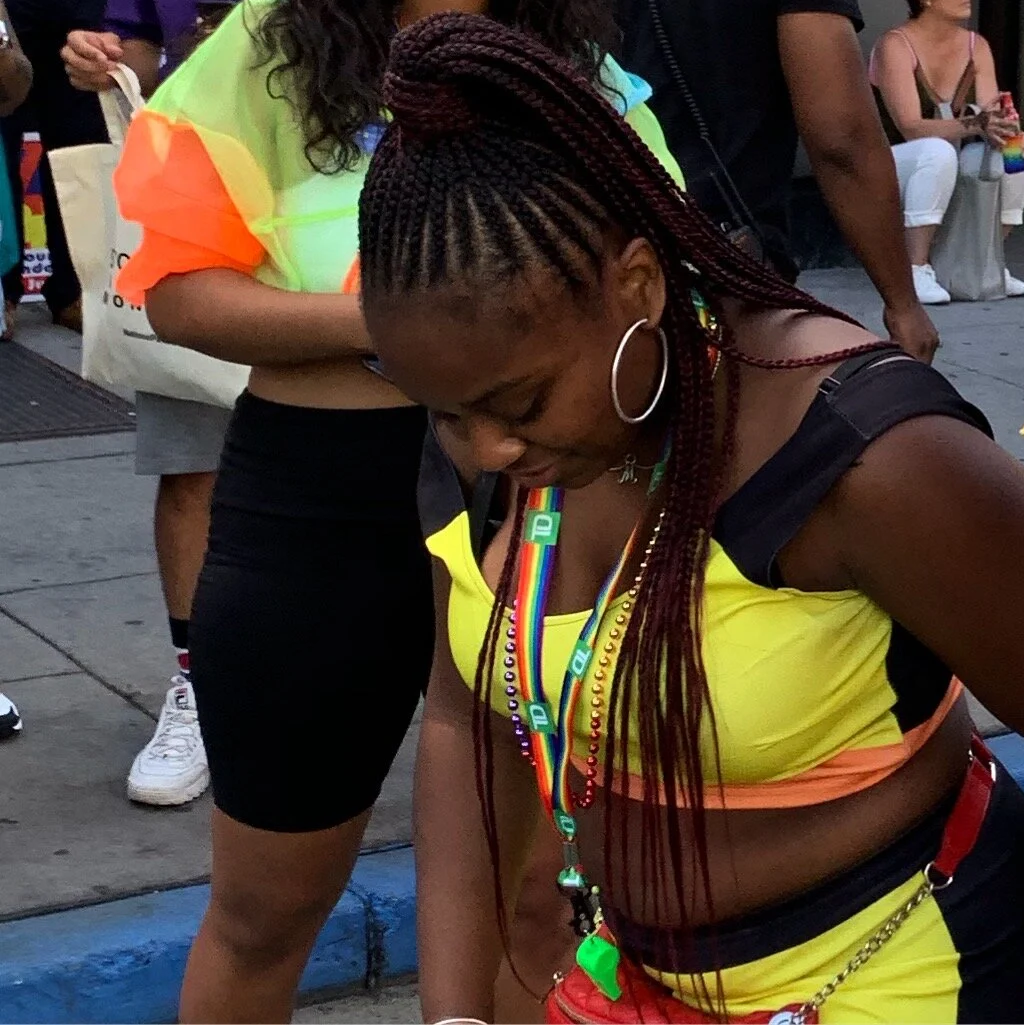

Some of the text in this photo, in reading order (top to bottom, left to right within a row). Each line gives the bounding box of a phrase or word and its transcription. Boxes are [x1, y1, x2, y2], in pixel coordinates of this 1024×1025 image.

[532, 514, 553, 540] TD
[571, 648, 592, 674] TD
[529, 704, 549, 729] TD
